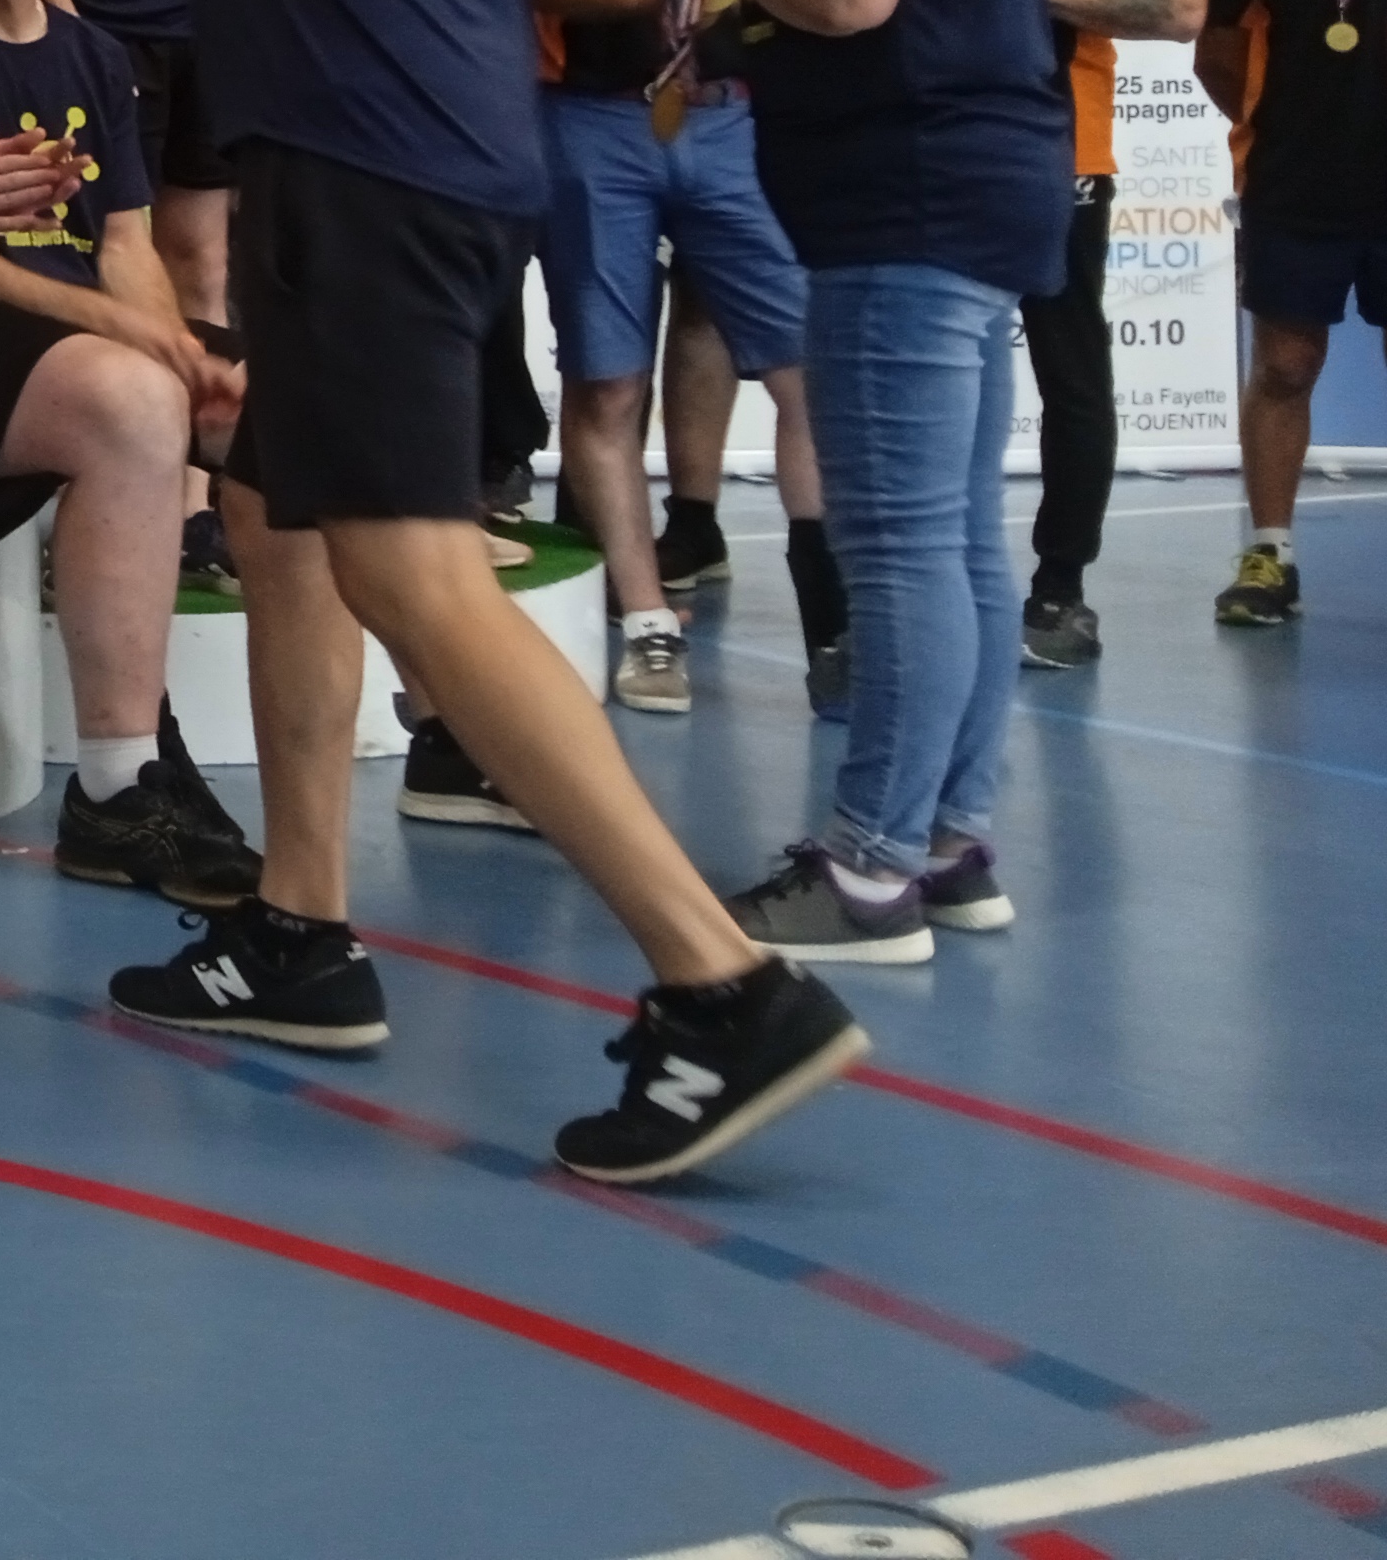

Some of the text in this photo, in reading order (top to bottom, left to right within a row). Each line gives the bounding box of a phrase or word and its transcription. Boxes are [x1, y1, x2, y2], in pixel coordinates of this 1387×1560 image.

[1152, 78, 1193, 95] ans
[1131, 390, 1154, 406] La
[1160, 388, 1227, 408] Fayette
